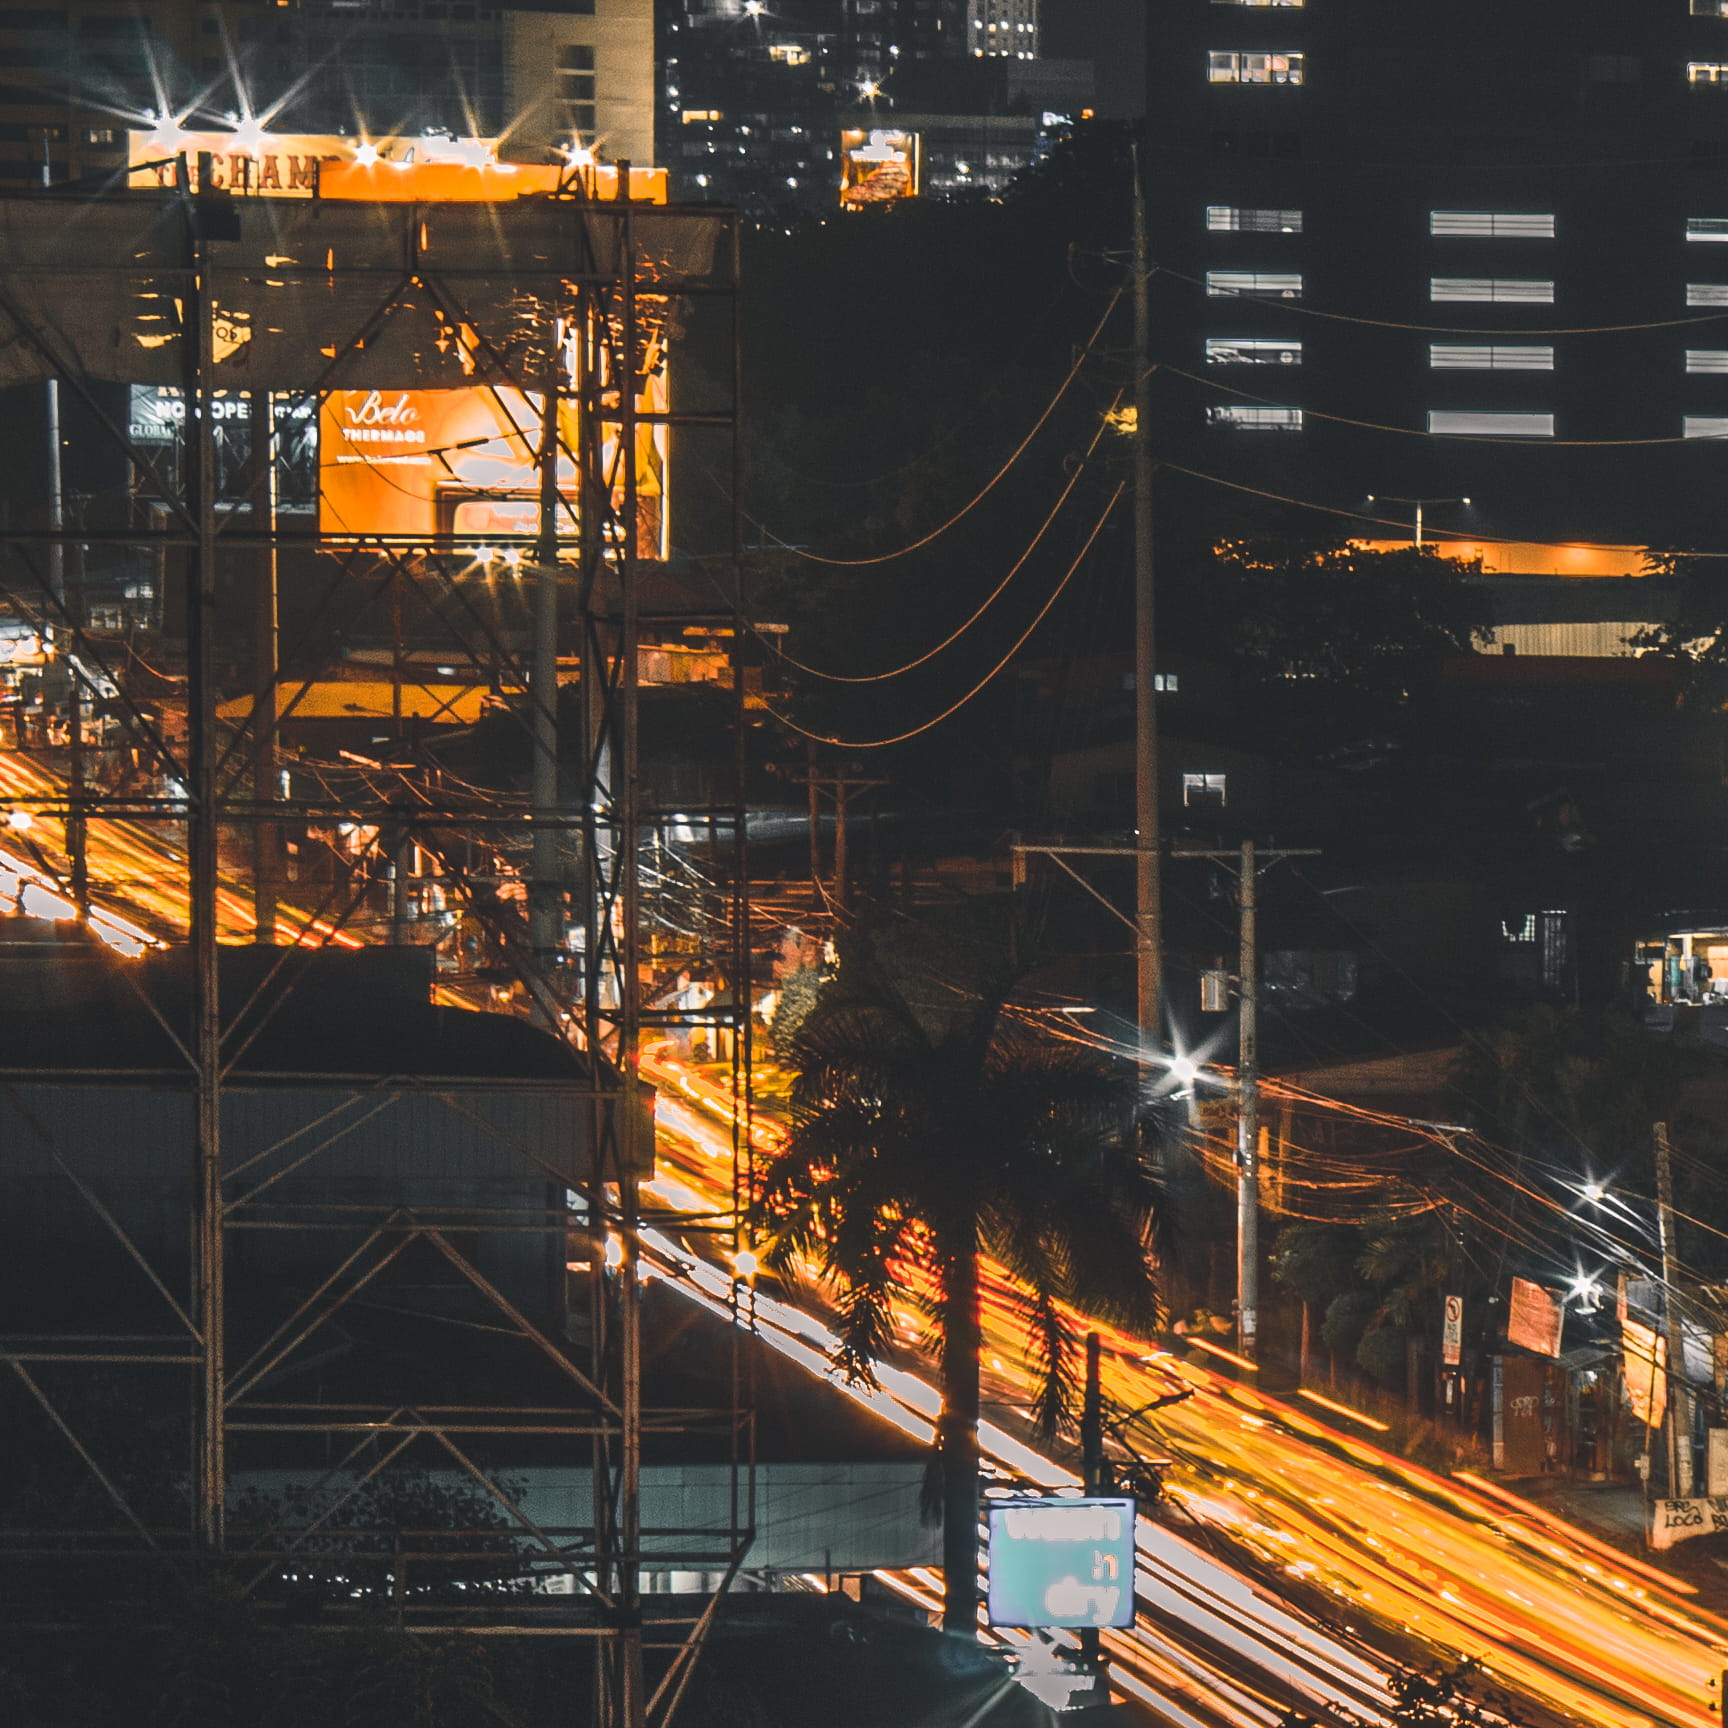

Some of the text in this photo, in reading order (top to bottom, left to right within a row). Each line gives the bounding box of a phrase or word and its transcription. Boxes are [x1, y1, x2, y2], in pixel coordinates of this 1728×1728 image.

[209, 154, 341, 190] CHAM
[211, 401, 252, 418] OPE
[344, 390, 420, 425] Belo
